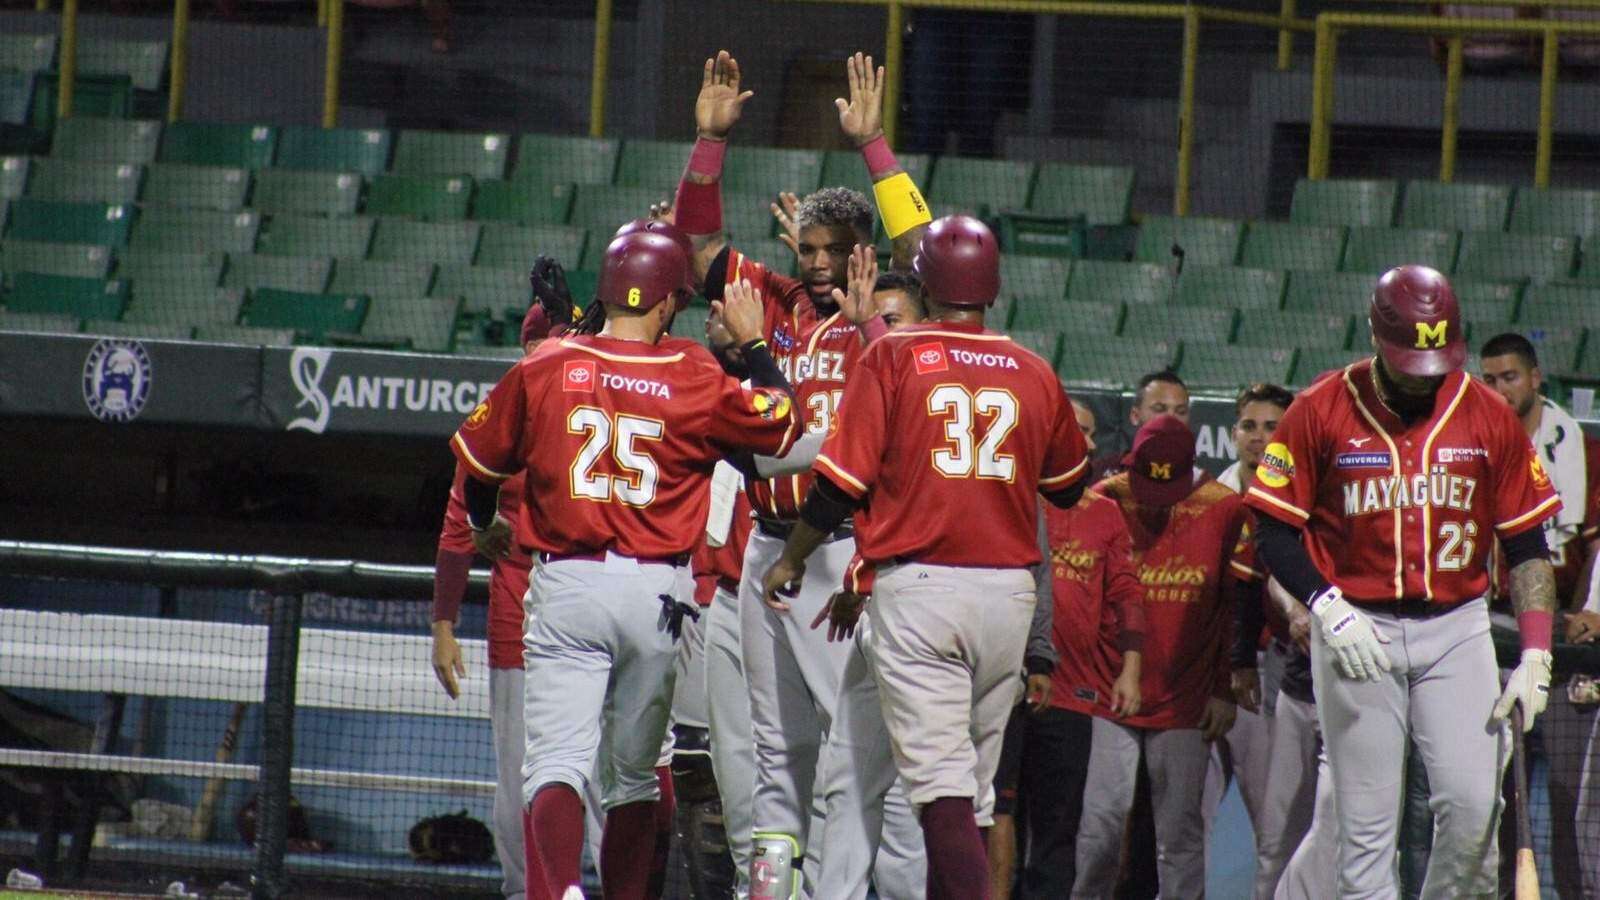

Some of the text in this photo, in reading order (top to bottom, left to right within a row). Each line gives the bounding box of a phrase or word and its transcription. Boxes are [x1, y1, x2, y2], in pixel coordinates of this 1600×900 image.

[627, 287, 641, 307] 6
[1414, 320, 1448, 349] M
[950, 348, 1018, 370] TOYOTA
[600, 373, 671, 400] TOYOTA
[926, 382, 1019, 483] 32
[566, 404, 665, 508] 25
[1338, 455, 1389, 465] UNIVERSAL
[1150, 462, 1172, 480] M
[1343, 463, 1478, 518] MAYAGÜEZ
[1436, 519, 1479, 572] 26
